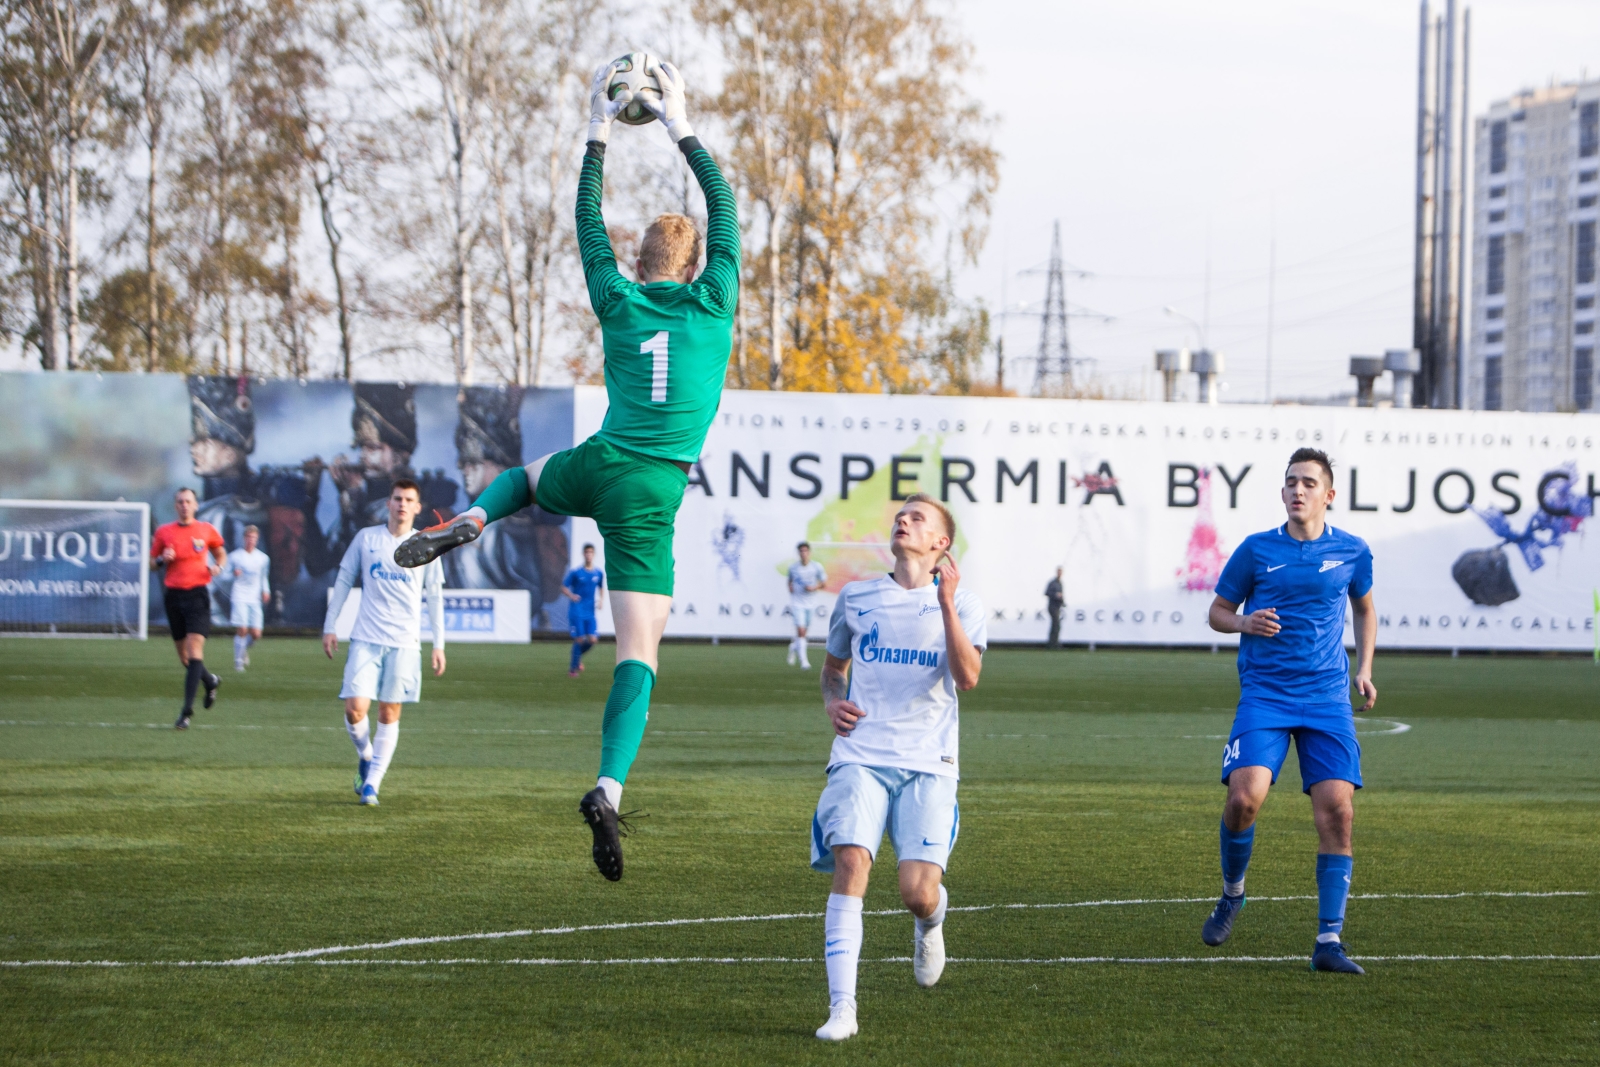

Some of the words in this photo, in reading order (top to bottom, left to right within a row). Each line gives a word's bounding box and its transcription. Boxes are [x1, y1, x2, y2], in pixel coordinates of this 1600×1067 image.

[639, 330, 669, 402] 1
[1009, 420, 1148, 438] ВЫСТАВКА
[1364, 429, 1512, 448] EXHIBITION
[1167, 462, 1253, 509] BY
[878, 647, 939, 669] ГАЗПРОМ
[1223, 738, 1241, 768] 24
